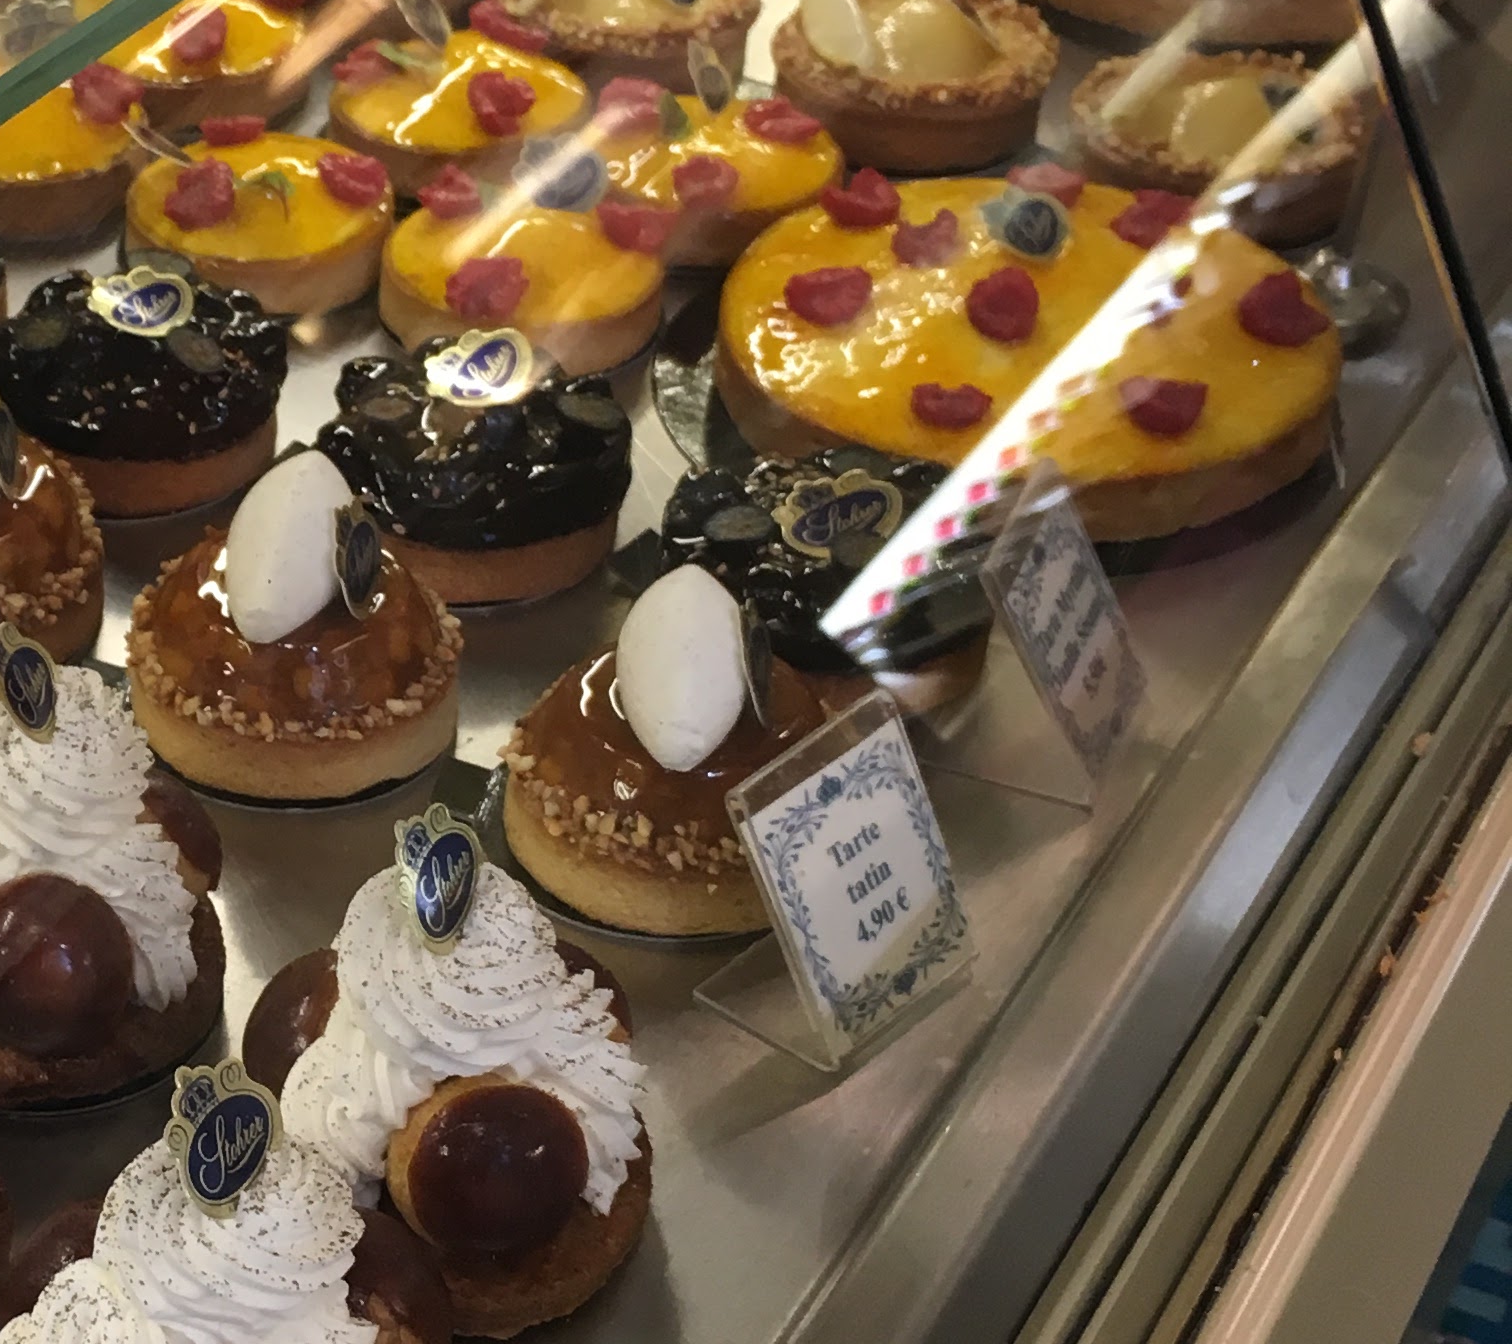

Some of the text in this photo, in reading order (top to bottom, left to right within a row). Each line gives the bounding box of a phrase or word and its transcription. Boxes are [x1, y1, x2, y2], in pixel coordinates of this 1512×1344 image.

[827, 822, 880, 868] Tarte
[846, 862, 892, 904] tatin
[858, 900, 895, 941] 4,90
[198, 1115, 266, 1193] Stohrer
